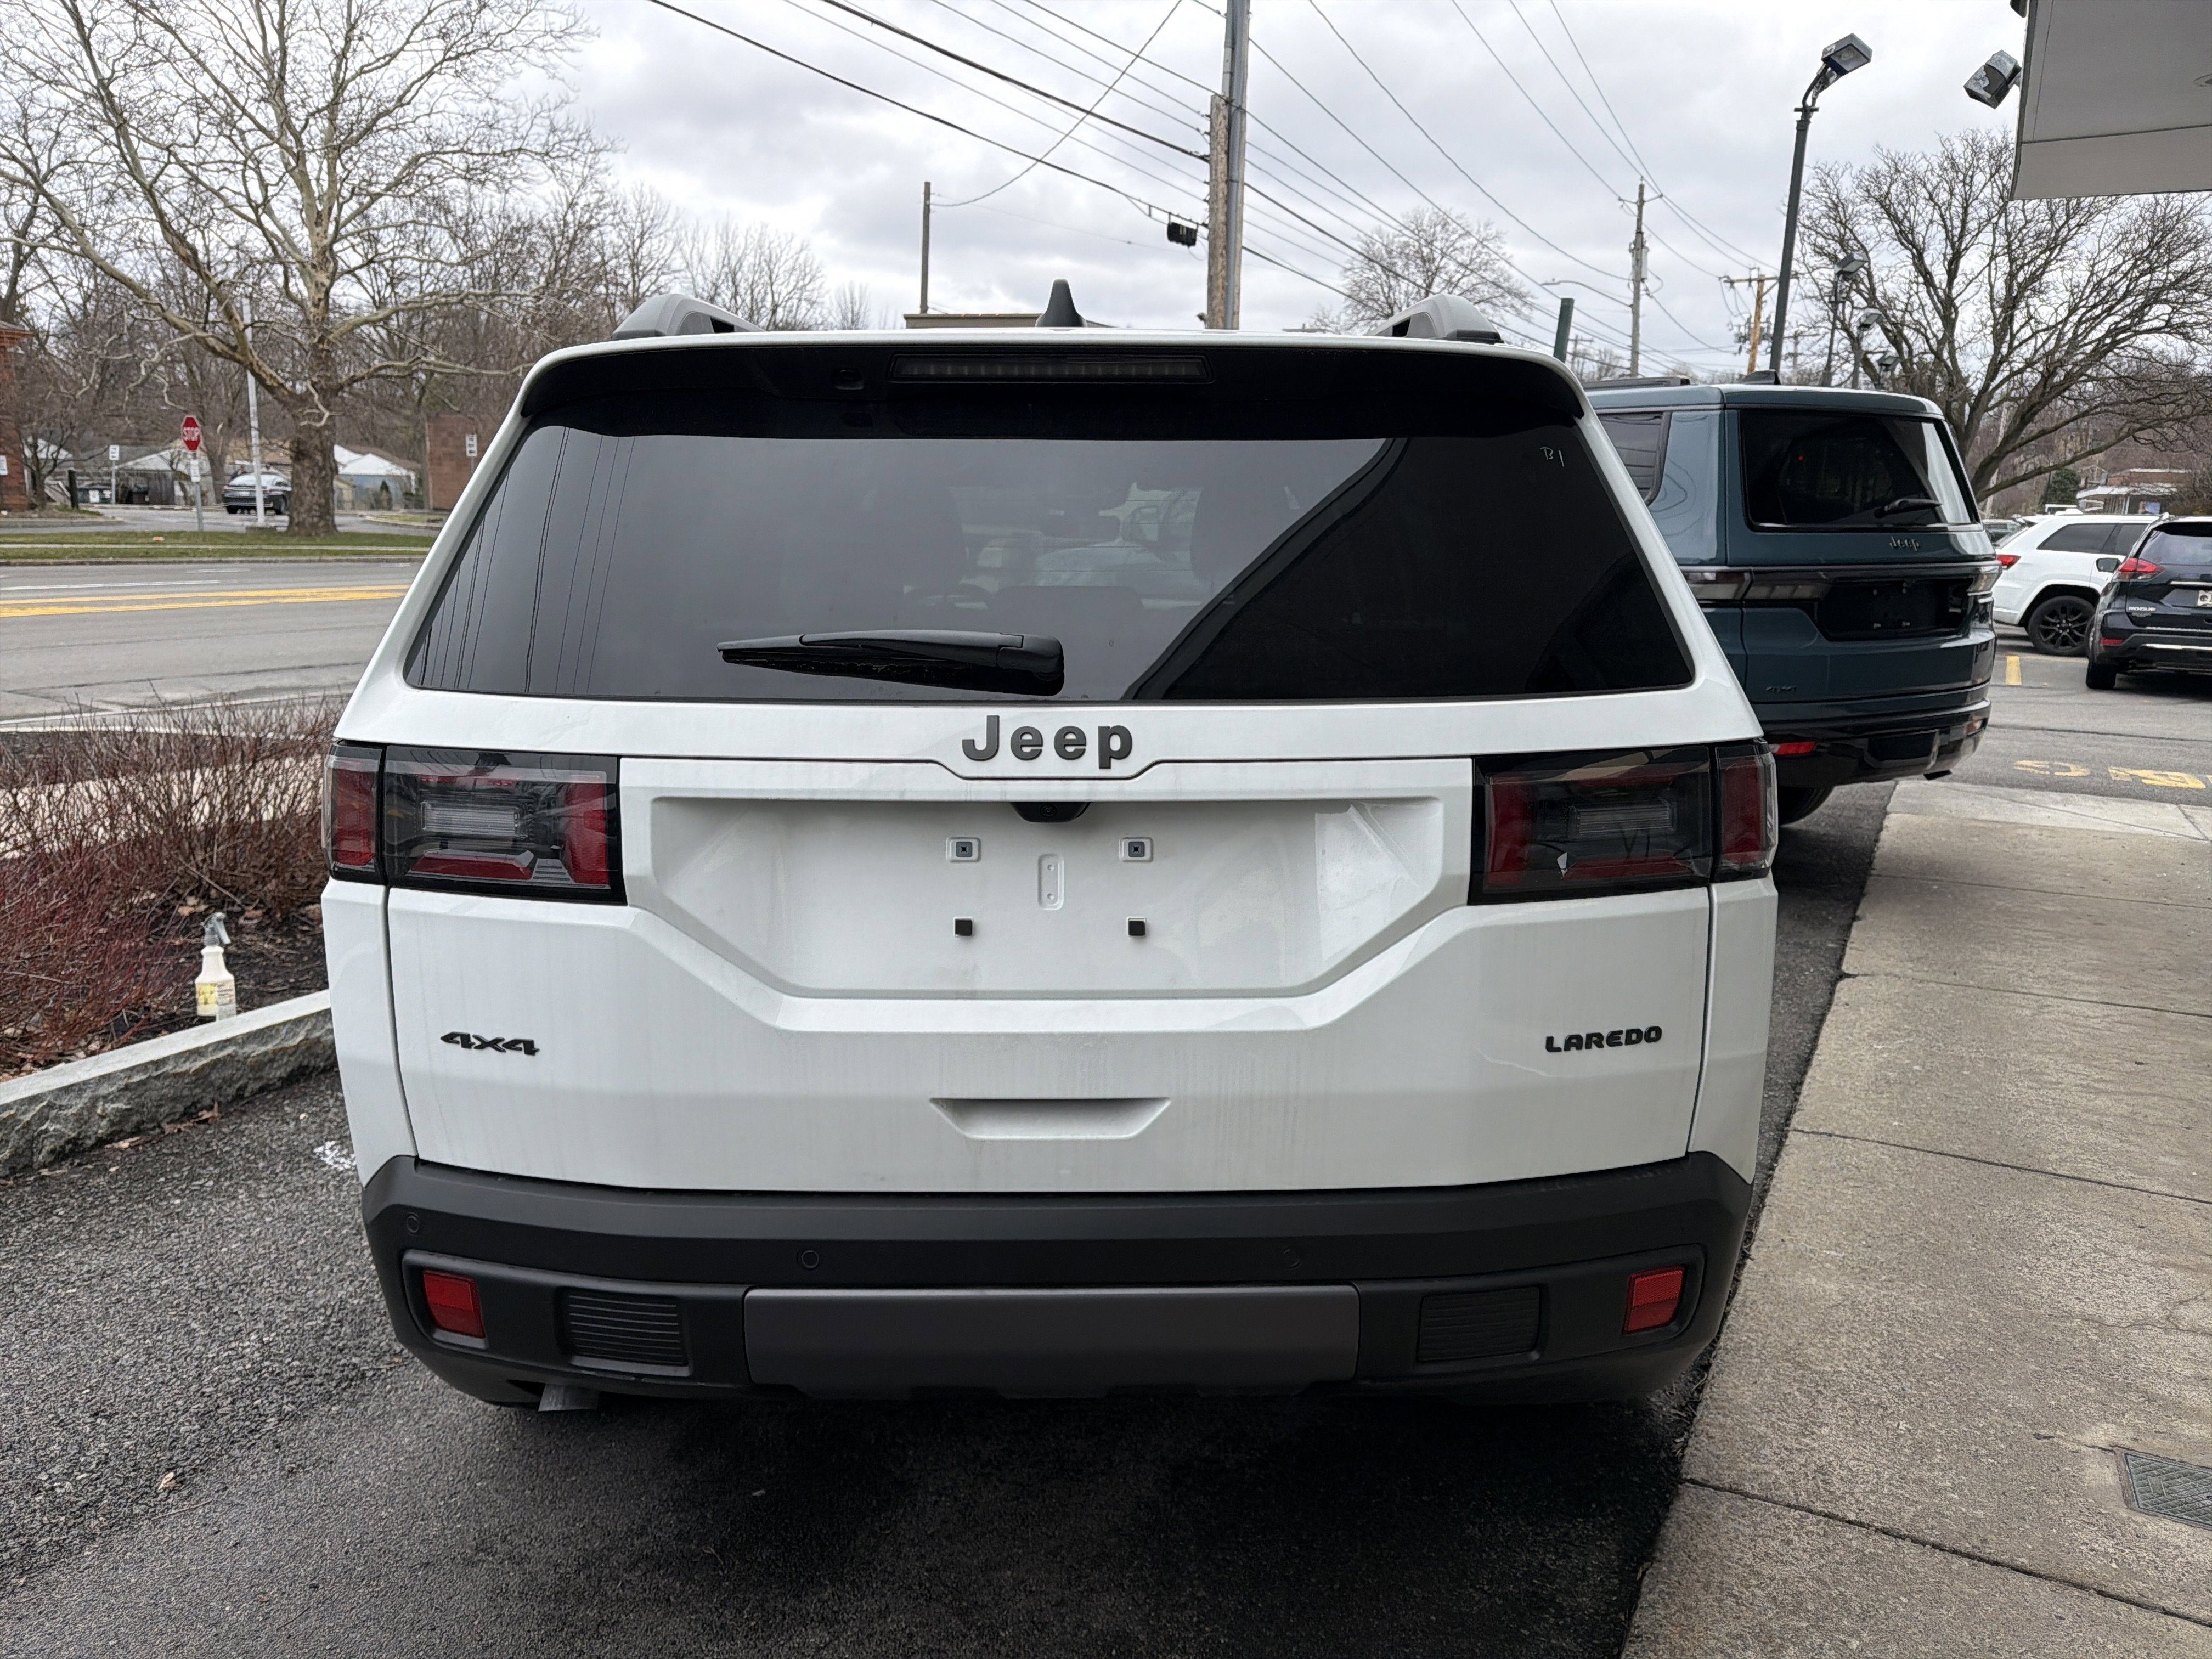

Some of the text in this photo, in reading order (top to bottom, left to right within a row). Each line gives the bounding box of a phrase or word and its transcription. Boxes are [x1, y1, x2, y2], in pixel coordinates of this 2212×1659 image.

[183, 427, 200, 441] STOP
[1889, 536, 1920, 551] Jeep
[962, 715, 1133, 769] Jeep
[441, 1031, 540, 1056] 4x4
[1545, 1026, 1662, 1053] LAREDO
